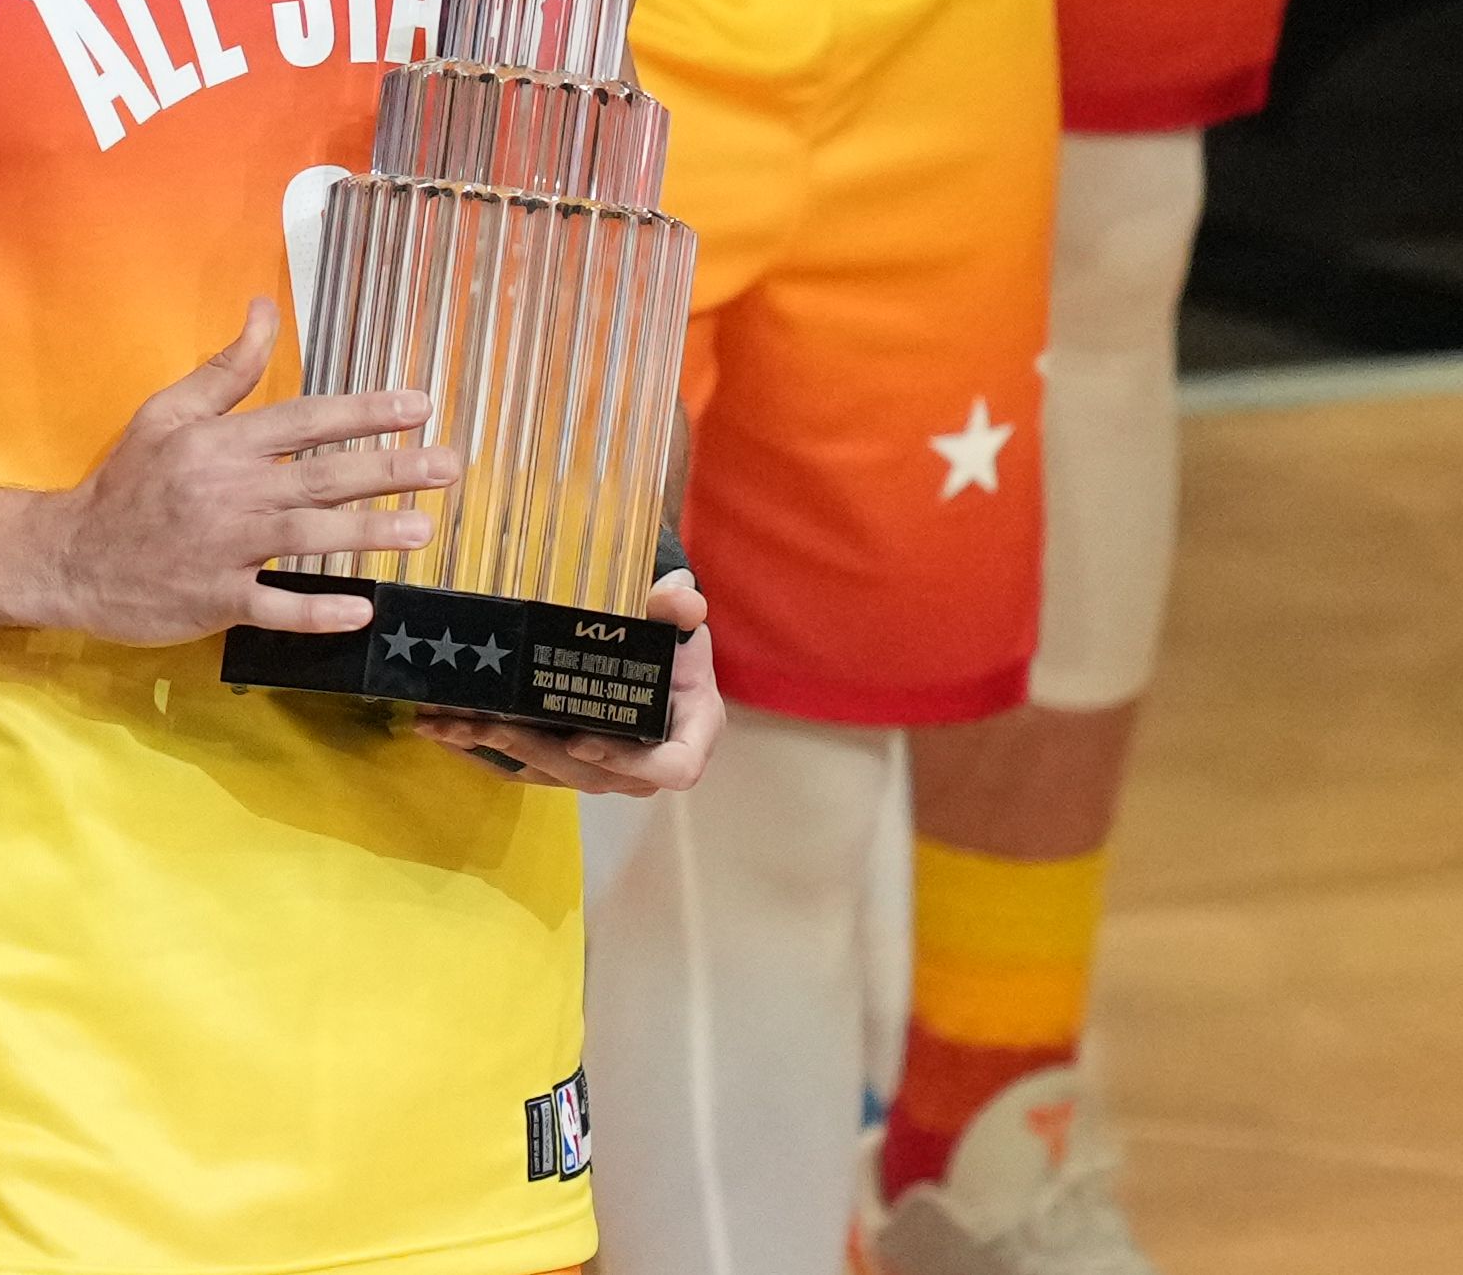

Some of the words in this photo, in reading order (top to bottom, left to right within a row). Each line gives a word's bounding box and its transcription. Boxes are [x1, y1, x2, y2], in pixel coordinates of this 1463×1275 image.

[575, 620, 625, 642] KIA
[532, 670, 553, 688] 2023
[554, 672, 569, 691] KIA
[570, 675, 587, 695] NBA
[589, 679, 628, 702] ALL-STAR
[629, 685, 654, 705] GAME
[542, 693, 566, 712] MOST
[567, 696, 606, 718] VALUABLE
[607, 705, 637, 724] PLAYER
